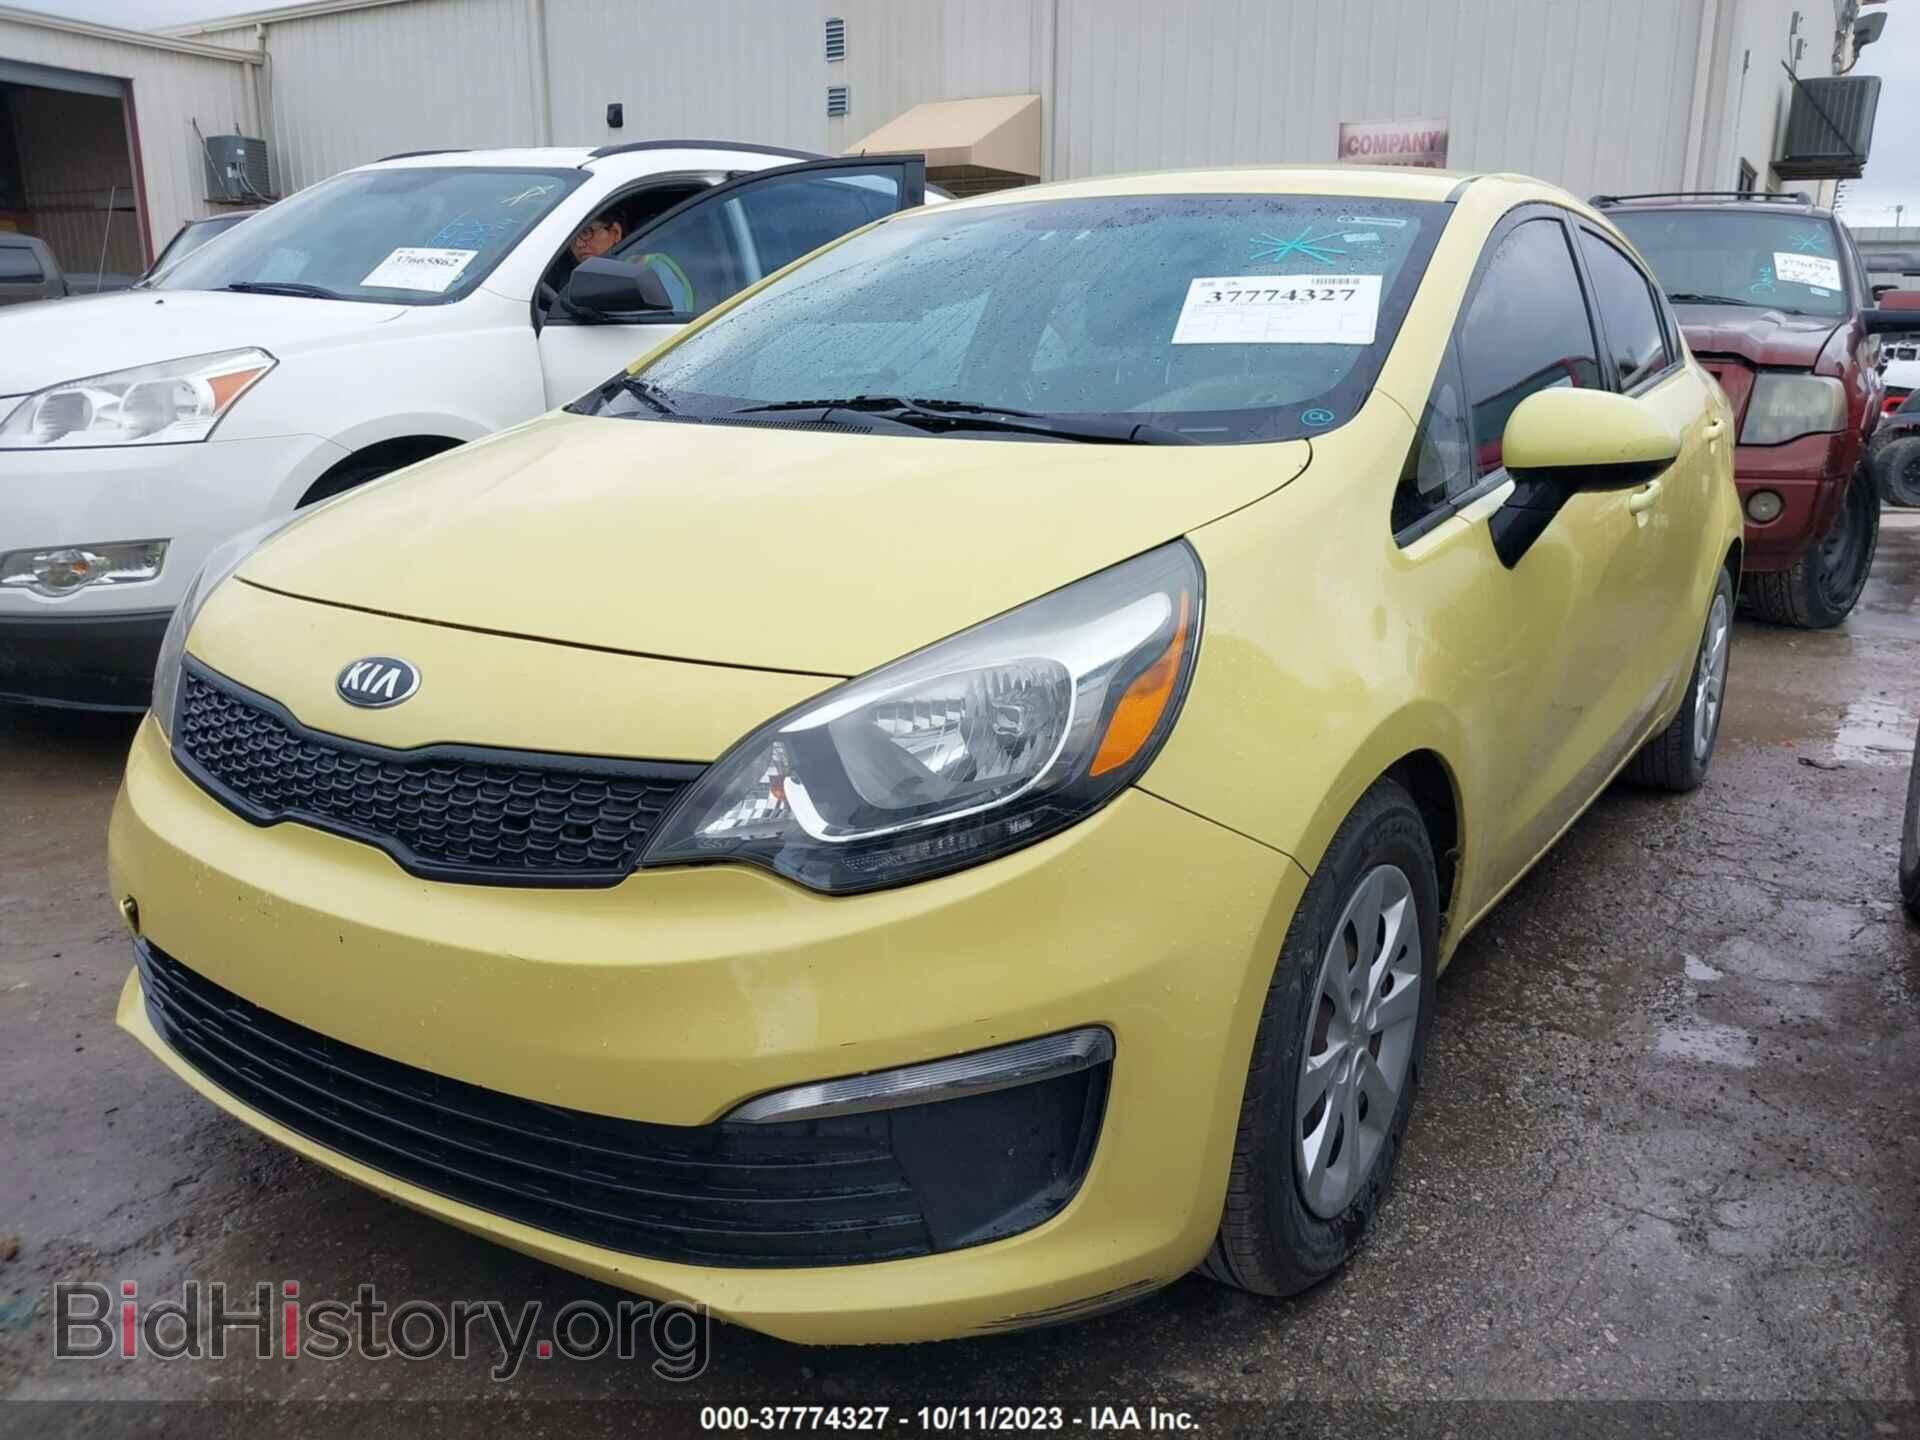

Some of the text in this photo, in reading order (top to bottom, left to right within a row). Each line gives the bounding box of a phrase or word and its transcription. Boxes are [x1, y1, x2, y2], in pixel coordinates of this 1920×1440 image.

[1347, 131, 1440, 156] COMPANY
[1205, 288, 1356, 304] 37774327
[341, 660, 402, 698] KIA
